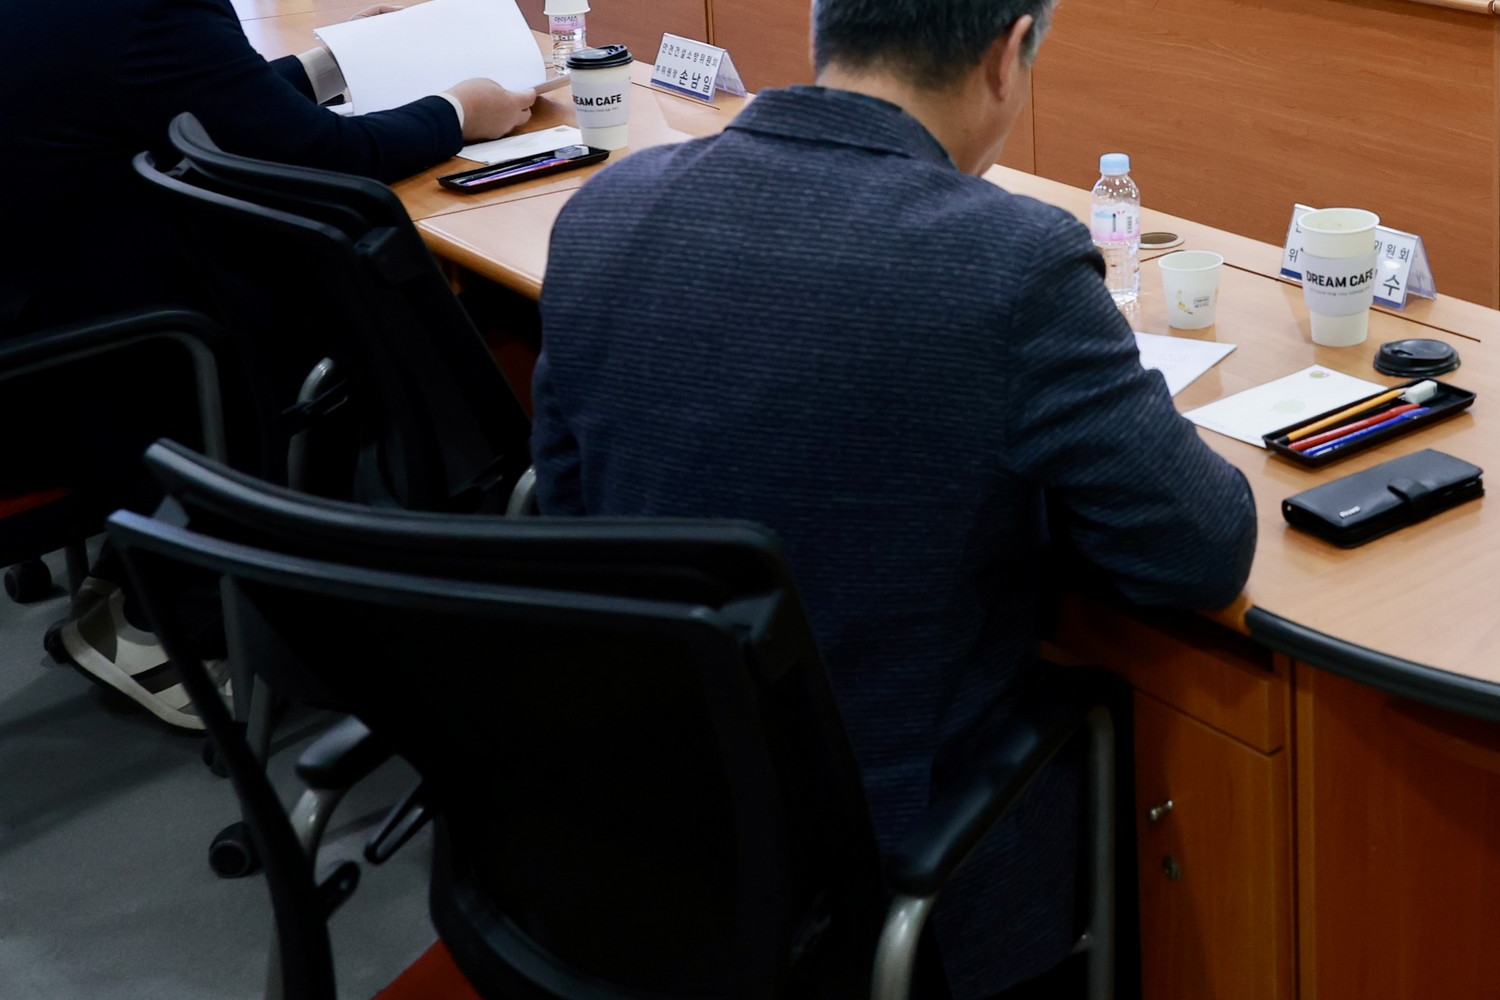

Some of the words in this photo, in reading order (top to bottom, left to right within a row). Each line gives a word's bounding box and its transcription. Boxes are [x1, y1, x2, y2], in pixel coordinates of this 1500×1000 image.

[595, 93, 622, 106] CAFE
[1306, 270, 1347, 289] DREAM
[1349, 267, 1374, 286] CAFE
